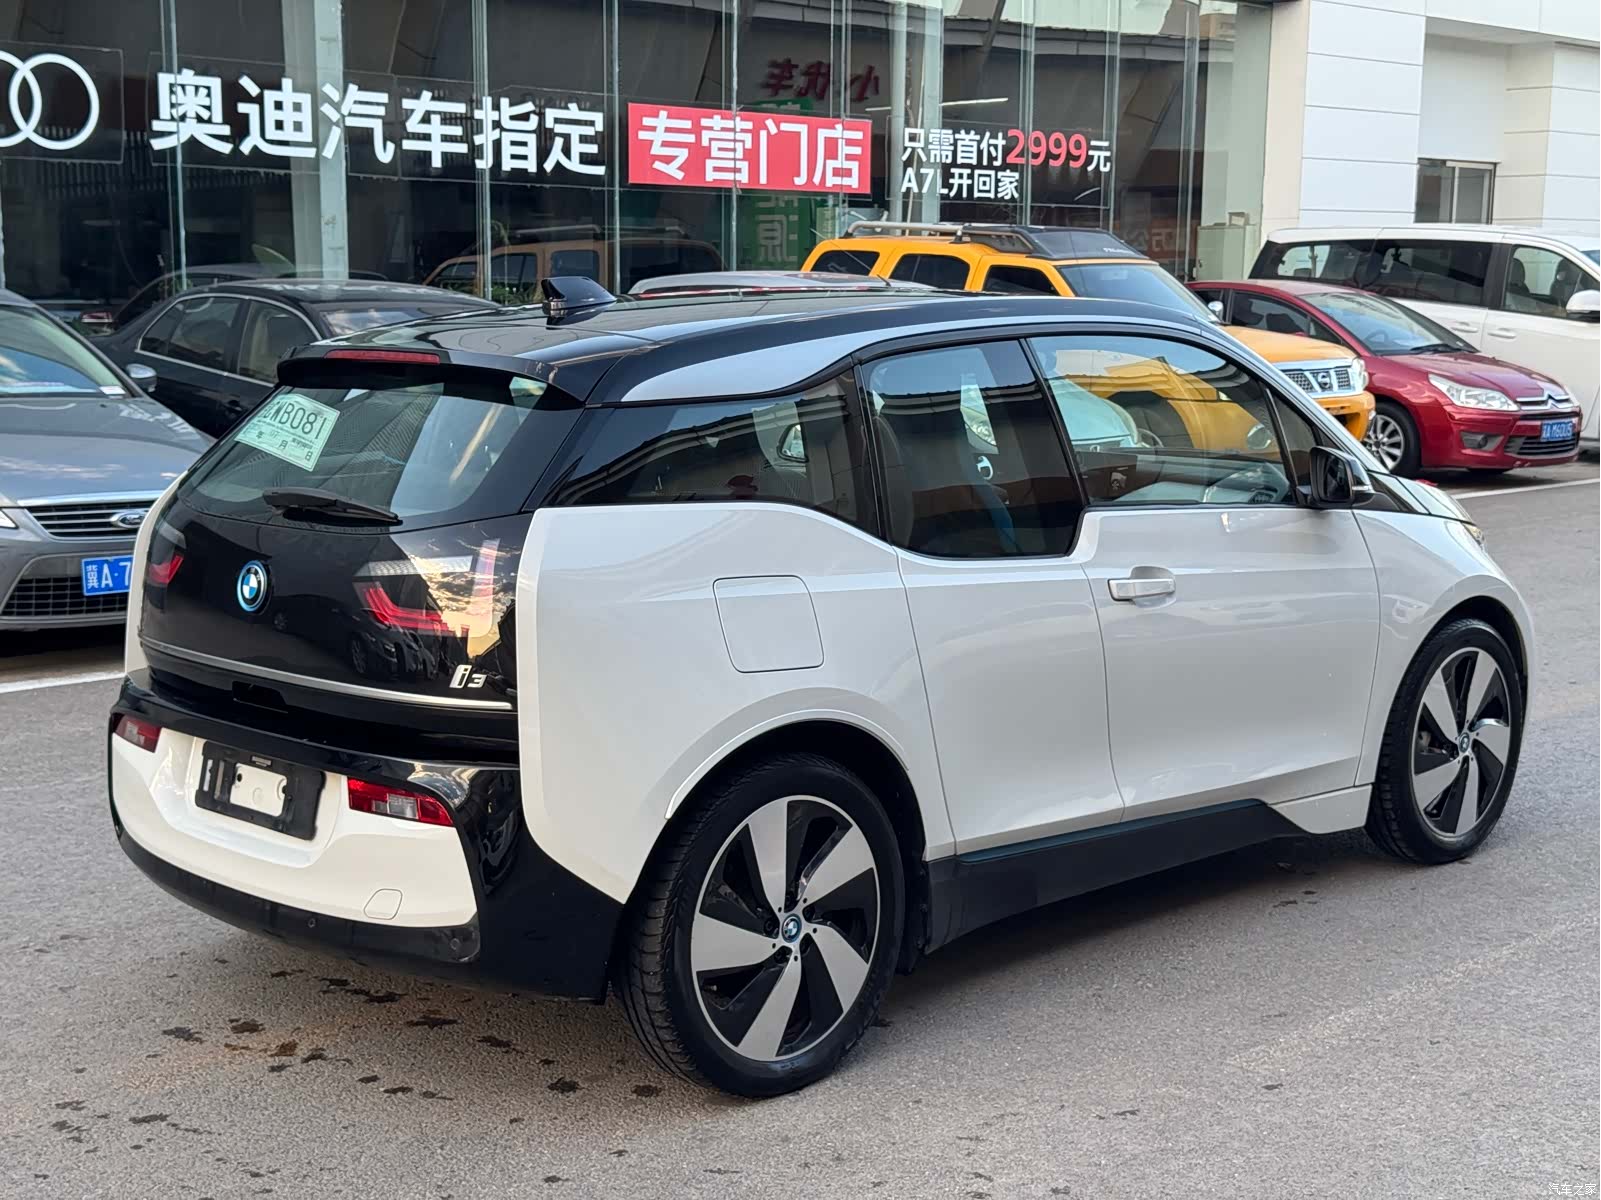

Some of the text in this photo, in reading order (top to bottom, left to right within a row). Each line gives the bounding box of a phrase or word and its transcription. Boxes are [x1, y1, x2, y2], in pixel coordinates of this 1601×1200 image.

[149, 67, 607, 176] 奥迪汽车指定
[636, 110, 865, 189] 专营门店
[901, 127, 1112, 173] 只需首付2999元
[901, 166, 1020, 201] A7L开回家
[449, 664, 488, 689] i3
